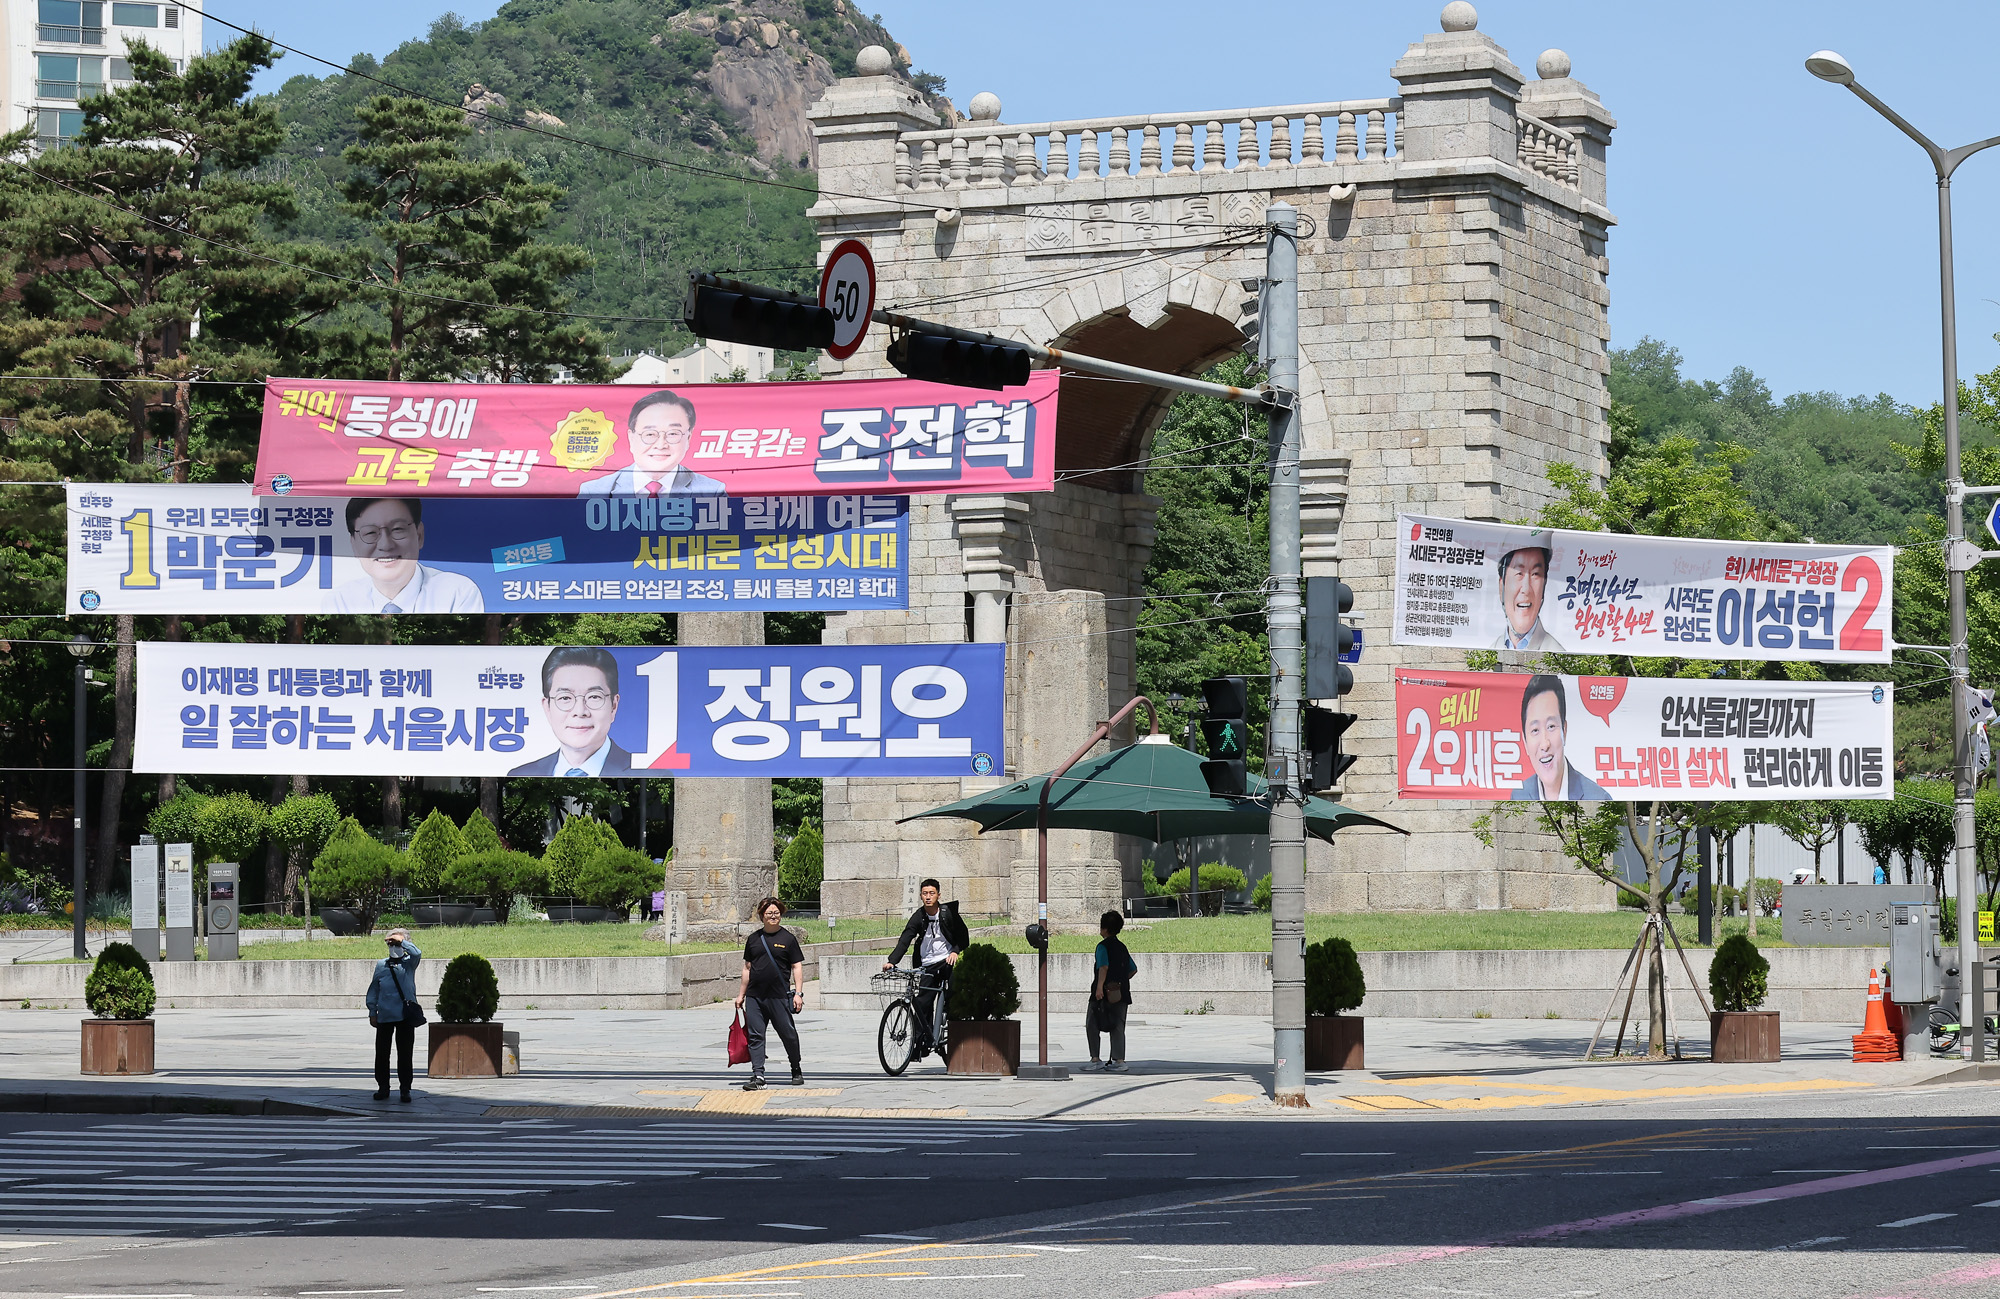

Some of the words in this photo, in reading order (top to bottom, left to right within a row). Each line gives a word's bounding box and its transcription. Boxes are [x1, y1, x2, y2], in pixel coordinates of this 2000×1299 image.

[833, 280, 859, 322] 50
[279, 390, 336, 417] 퀴어
[343, 396, 478, 440] 동성애
[567, 445, 599, 453] 단일후보
[568, 436, 599, 444] 중도보수
[693, 427, 807, 459] 교육감은
[814, 400, 1036, 482] 조전혁
[345, 447, 440, 487] 교육
[447, 448, 539, 488] 추방
[79, 496, 113, 508] 민주당
[166, 508, 204, 528] 우리
[210, 508, 269, 528] 모두의
[274, 508, 334, 528] 구청장
[585, 497, 732, 532] 이재명과
[742, 496, 814, 531] 함께
[826, 496, 897, 530] 여는
[81, 517, 112, 528] 서대문
[81, 530, 112, 541] 구청장
[1424, 527, 1454, 543] 국민의힘
[81, 543, 102, 554] 후보
[120, 508, 161, 591] 1
[166, 535, 333, 590] 박운기
[503, 541, 553, 566] 천연동
[633, 534, 740, 571] 서대문
[754, 533, 897, 570] 전성시대
[1409, 544, 1485, 566] 서대문구청장후보
[502, 580, 560, 601] 경사로
[564, 580, 621, 600] 스마트
[625, 579, 682, 600] 안심길
[686, 579, 729, 601] 조성,
[733, 579, 771, 599] 틈새
[775, 578, 813, 599] 돌봄
[817, 578, 854, 599] 지원
[858, 577, 897, 598] 확대
[1407, 572, 1426, 587] 서대문
[1558, 573, 1608, 610] 증명된
[1607, 575, 1643, 603] 4년
[1664, 587, 1713, 613] 시작도
[1840, 555, 1883, 651] 2
[1575, 604, 1626, 642] 완성할
[1624, 606, 1657, 636] 4년
[1663, 616, 1711, 642] 완성도
[1716, 588, 1835, 650] 이성헌
[181, 666, 259, 696] 이재명
[267, 667, 372, 697] 대통령과
[379, 668, 432, 698] 함께
[478, 674, 525, 689] 민주당
[1589, 684, 1616, 701] 천연동
[630, 651, 691, 770] 1
[704, 664, 972, 762] 정원오
[1439, 688, 1481, 728] 역시!
[1661, 696, 1815, 738] 안산둘레길까지
[179, 704, 219, 750] 일
[229, 705, 356, 751] 잘하는
[364, 706, 529, 752] 서울시장
[1406, 707, 1432, 786] 2
[1433, 728, 1524, 789] 오세훈
[1595, 746, 1682, 788] 모노레일
[1686, 747, 1736, 789] 설치,
[1744, 747, 1832, 787] 편리하게
[1839, 747, 1883, 787] 이동
